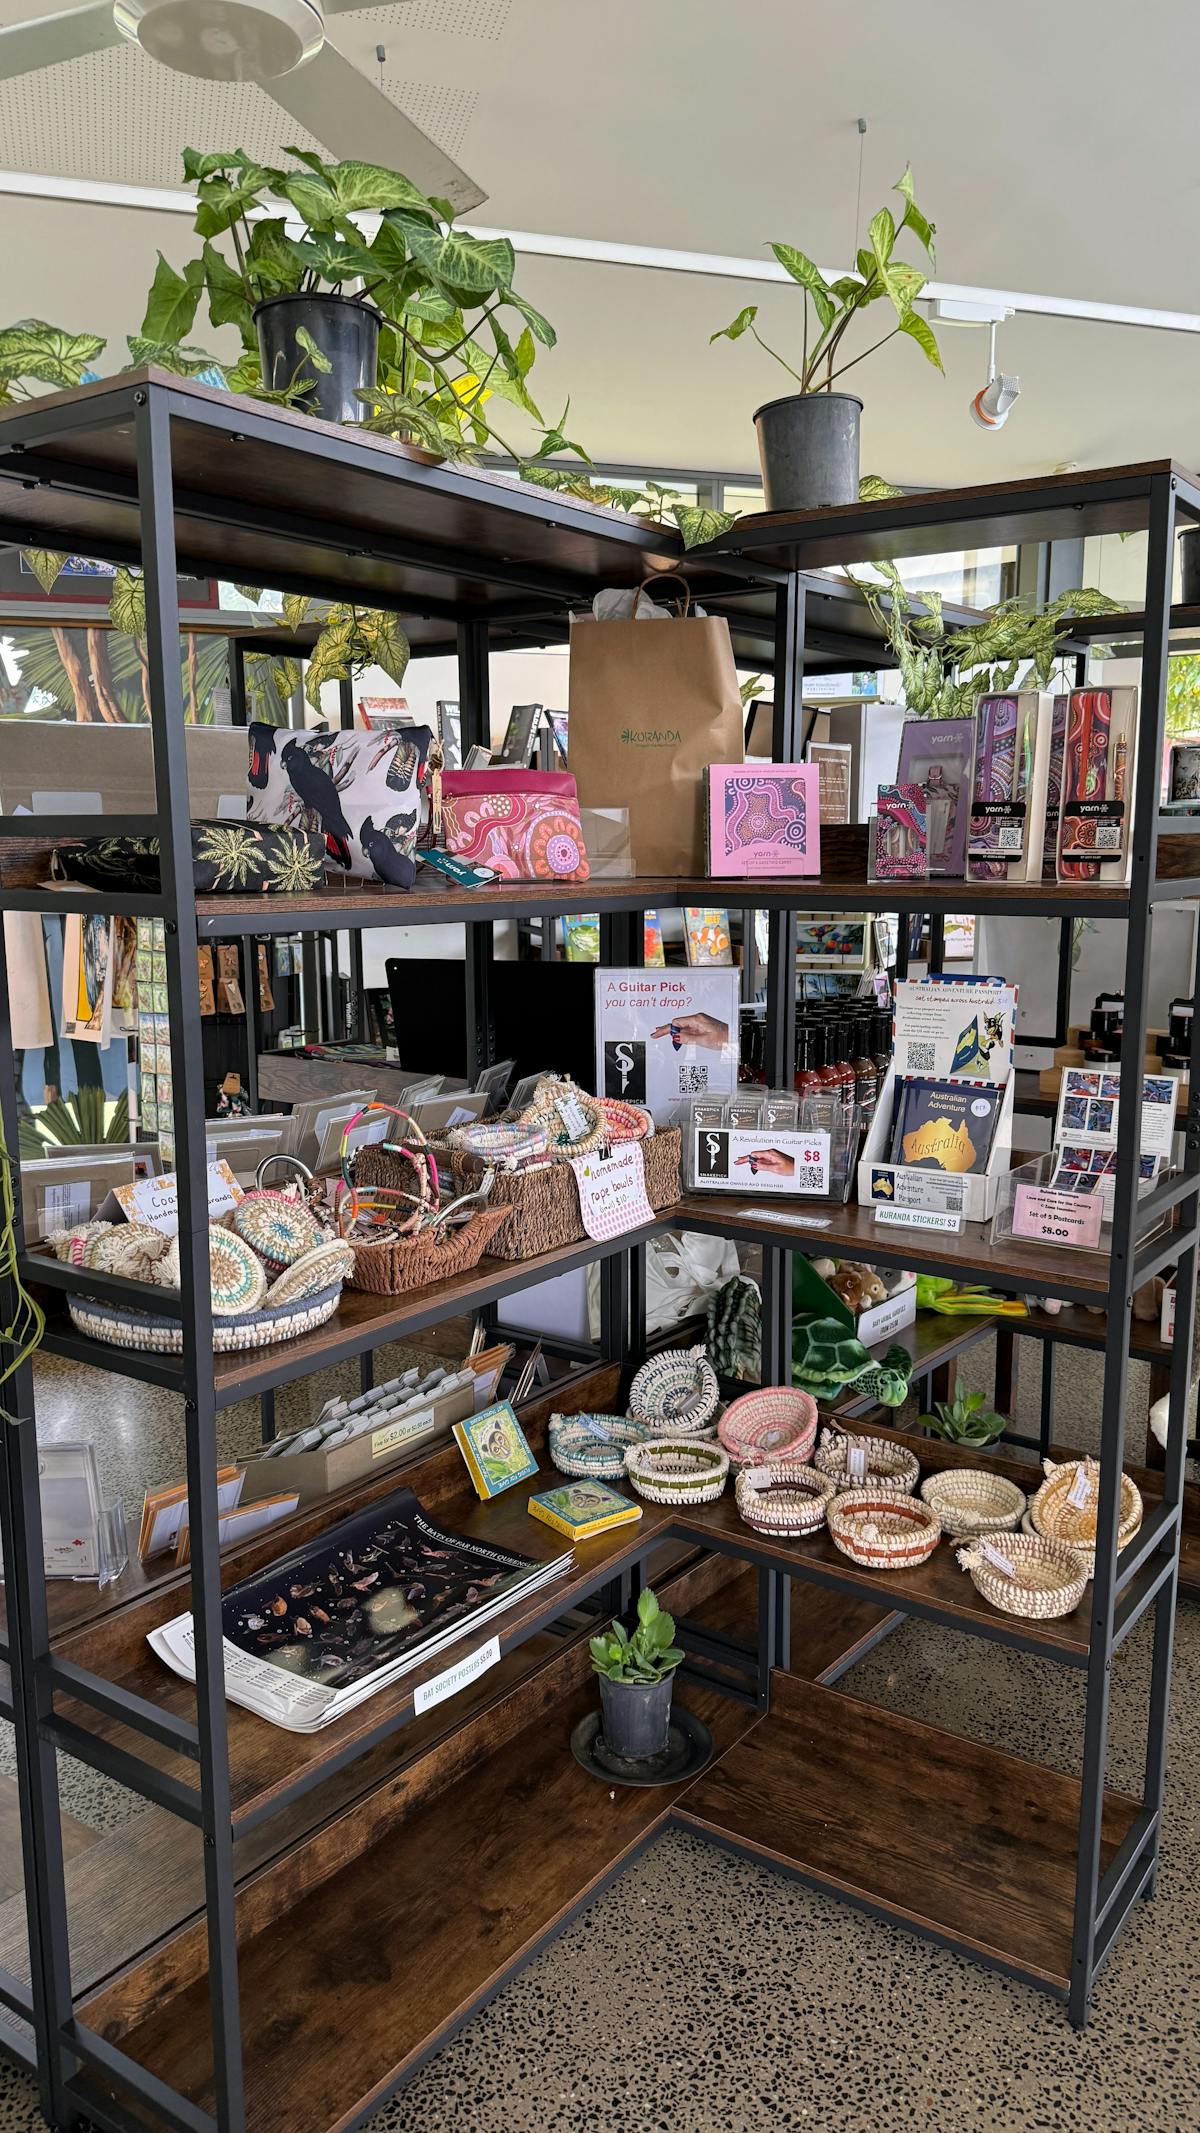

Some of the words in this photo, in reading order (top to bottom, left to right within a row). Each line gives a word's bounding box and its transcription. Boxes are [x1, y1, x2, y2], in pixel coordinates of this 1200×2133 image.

[931, 734, 954, 744] yarn
[886, 802, 906, 810] yarn
[985, 806, 1004, 814] yarn
[1080, 804, 1100, 813] yarn
[754, 850, 771, 858] yarn
[607, 982, 616, 992] A
[618, 982, 656, 992] Guitar
[660, 982, 686, 992] Pick
[604, 999, 626, 1010] you
[629, 996, 656, 1007] can't
[660, 996, 692, 1009] drop?
[930, 1092, 968, 1104] Australian
[928, 1100, 966, 1113] Adventure
[740, 1135, 774, 1145] Revolution
[911, 1134, 966, 1156] Australia
[804, 1150, 820, 1162] $8
[590, 1152, 634, 1181] homemade
[590, 1186, 610, 1204] rope
[611, 1174, 634, 1192] bowls
[880, 1210, 910, 1222] KURANDA
[946, 1218, 957, 1228] $3
[1054, 1214, 1085, 1225] Postcards
[1041, 1226, 1069, 1237] $8.00
[390, 1428, 406, 1441] $2.00
[414, 1514, 428, 1530] THE
[426, 1526, 446, 1544] BATS
[445, 1536, 458, 1545] OF
[456, 1540, 470, 1550] FAR
[470, 1544, 498, 1558] NORTH
[424, 1688, 434, 1701] BAT
[436, 1674, 457, 1694] SOCIETY
[458, 1658, 480, 1680] POSTERS
